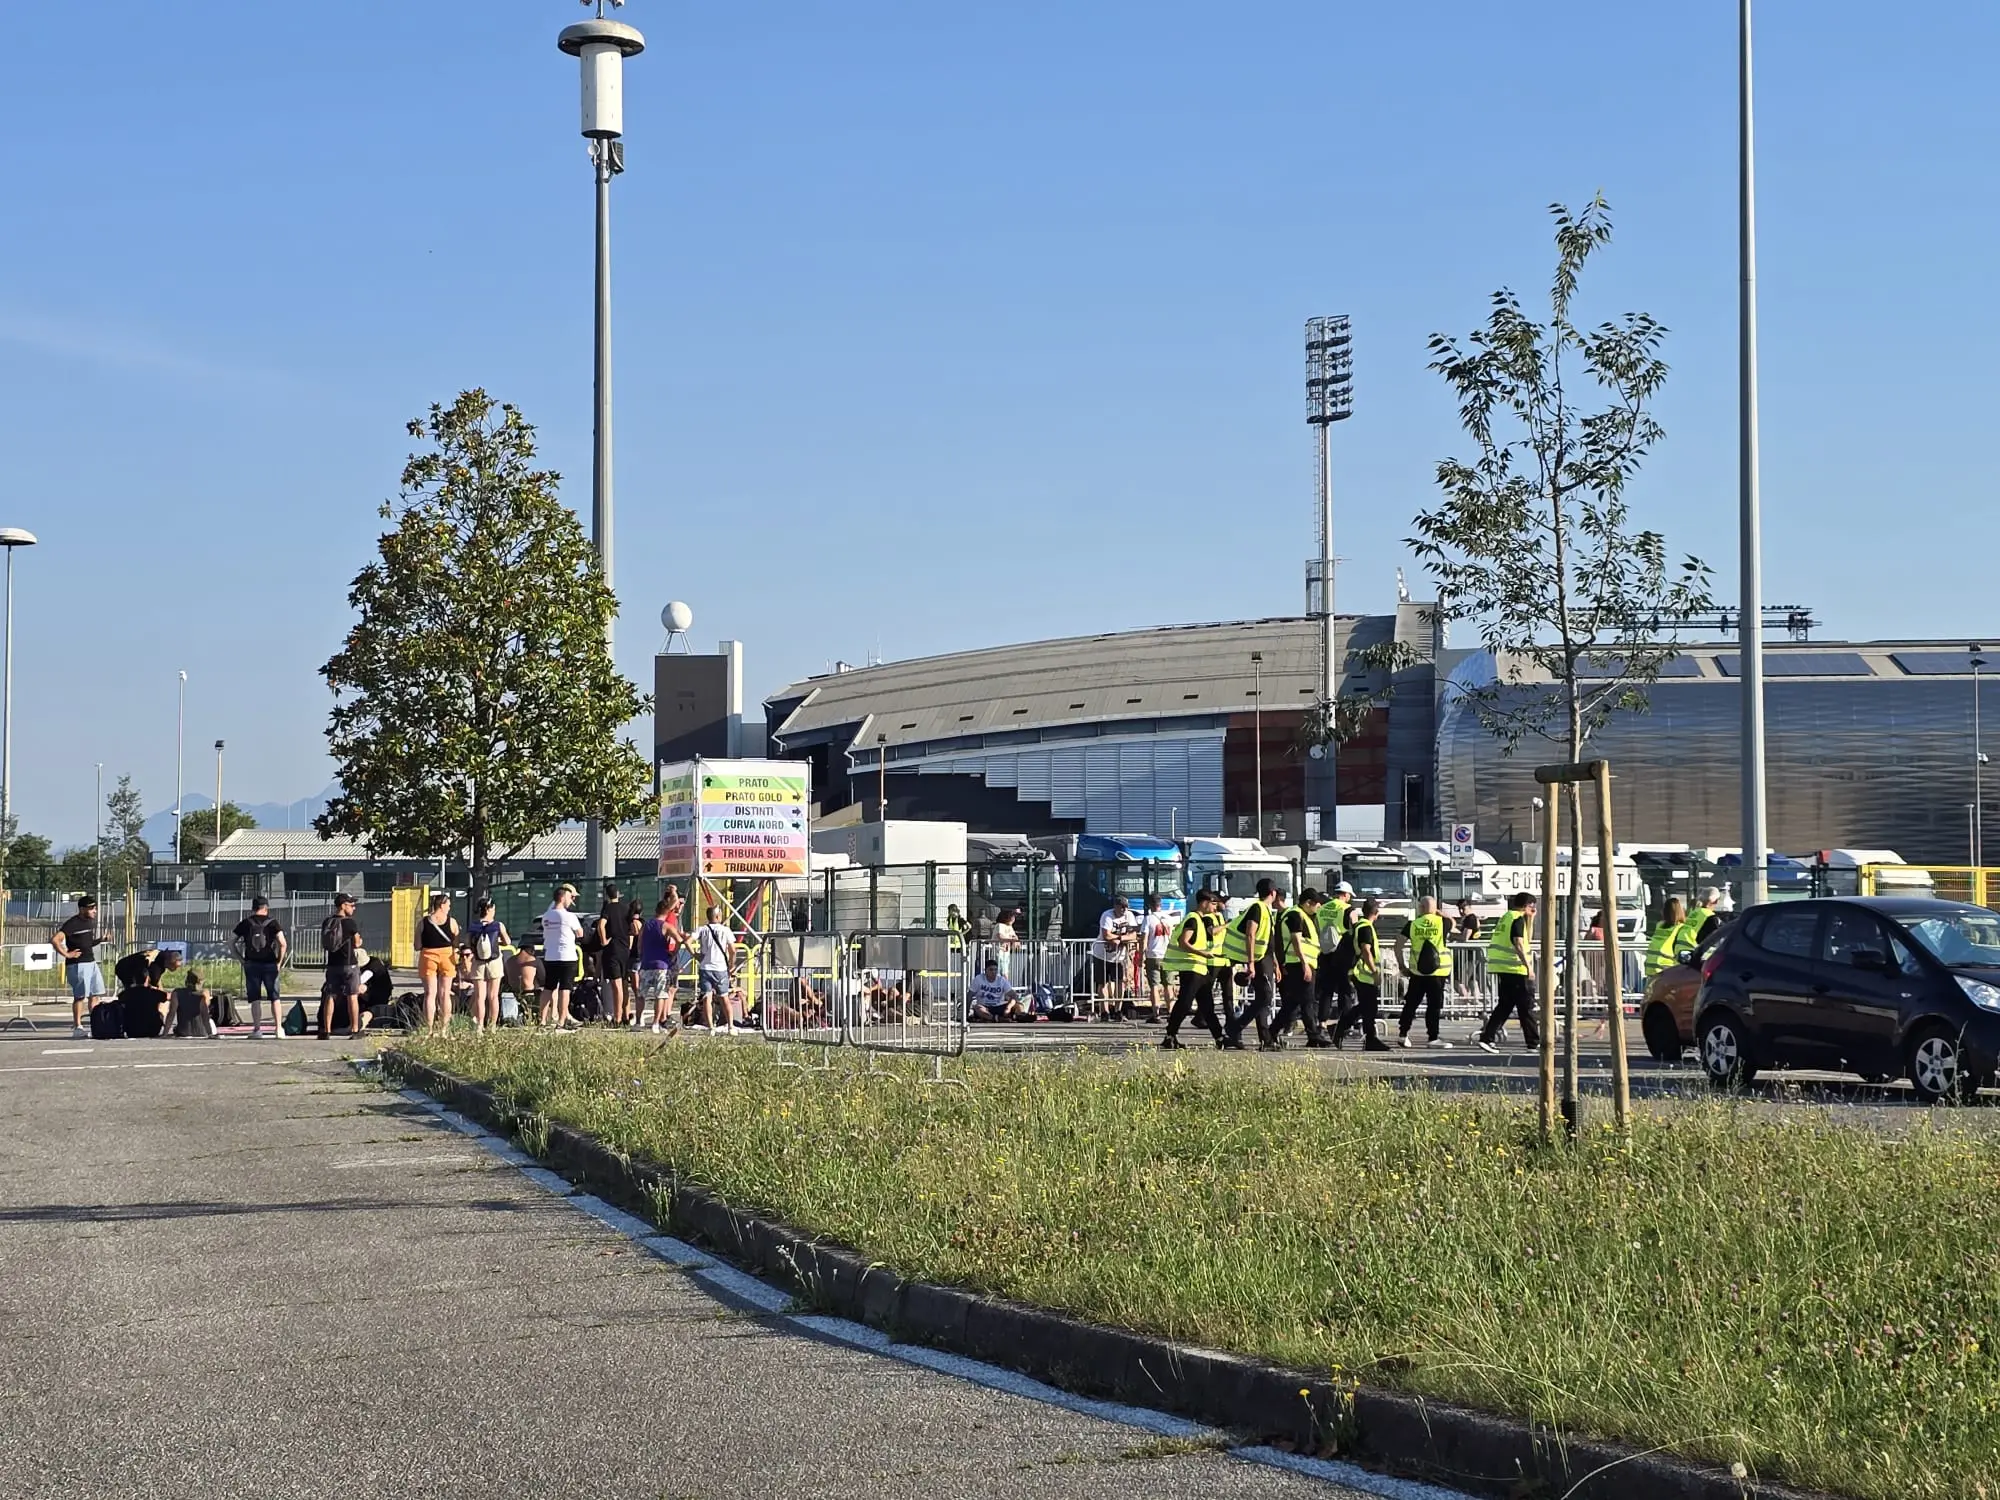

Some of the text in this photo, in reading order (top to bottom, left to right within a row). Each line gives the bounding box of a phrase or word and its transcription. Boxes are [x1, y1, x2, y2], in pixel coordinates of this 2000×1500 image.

[739, 778, 769, 787] PRATO
[725, 792, 783, 802] PRATO GOLD
[735, 806, 774, 816] DISTINTI
[723, 819, 784, 830] CURVA NORD
[718, 834, 789, 844] TRIBUNA NORD
[722, 848, 786, 859] TRIBUNA SUD
[724, 862, 784, 873] TRIBUNA VIP
[1512, 871, 1566, 889] CURA
